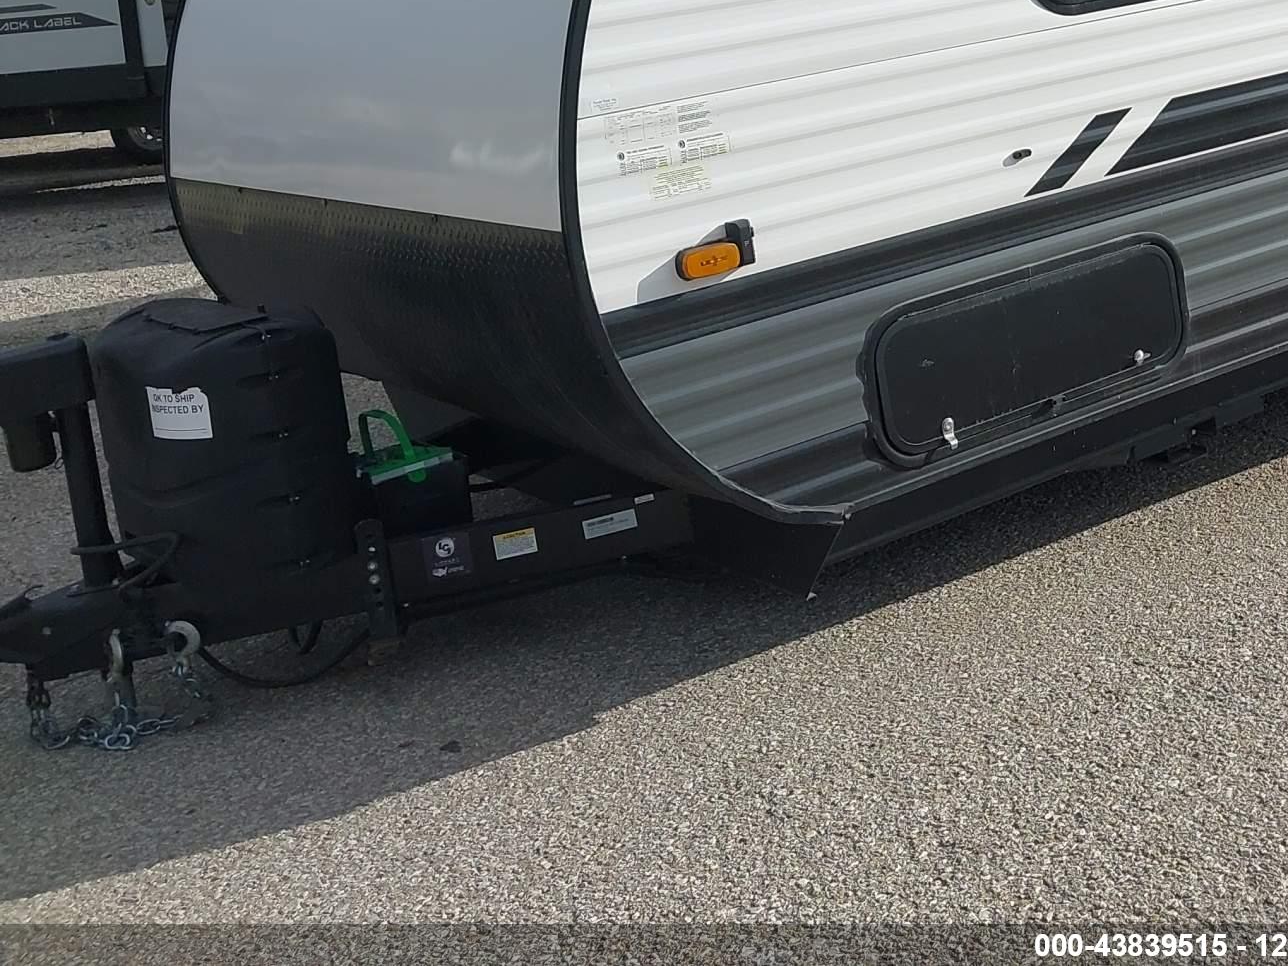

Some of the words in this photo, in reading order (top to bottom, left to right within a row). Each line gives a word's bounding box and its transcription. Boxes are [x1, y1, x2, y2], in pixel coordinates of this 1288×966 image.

[33, 16, 82, 29] LABEL
[163, 394, 174, 403] TO
[174, 393, 196, 403] SHIP
[151, 404, 189, 414] NSPECTED
[191, 404, 204, 414] BY
